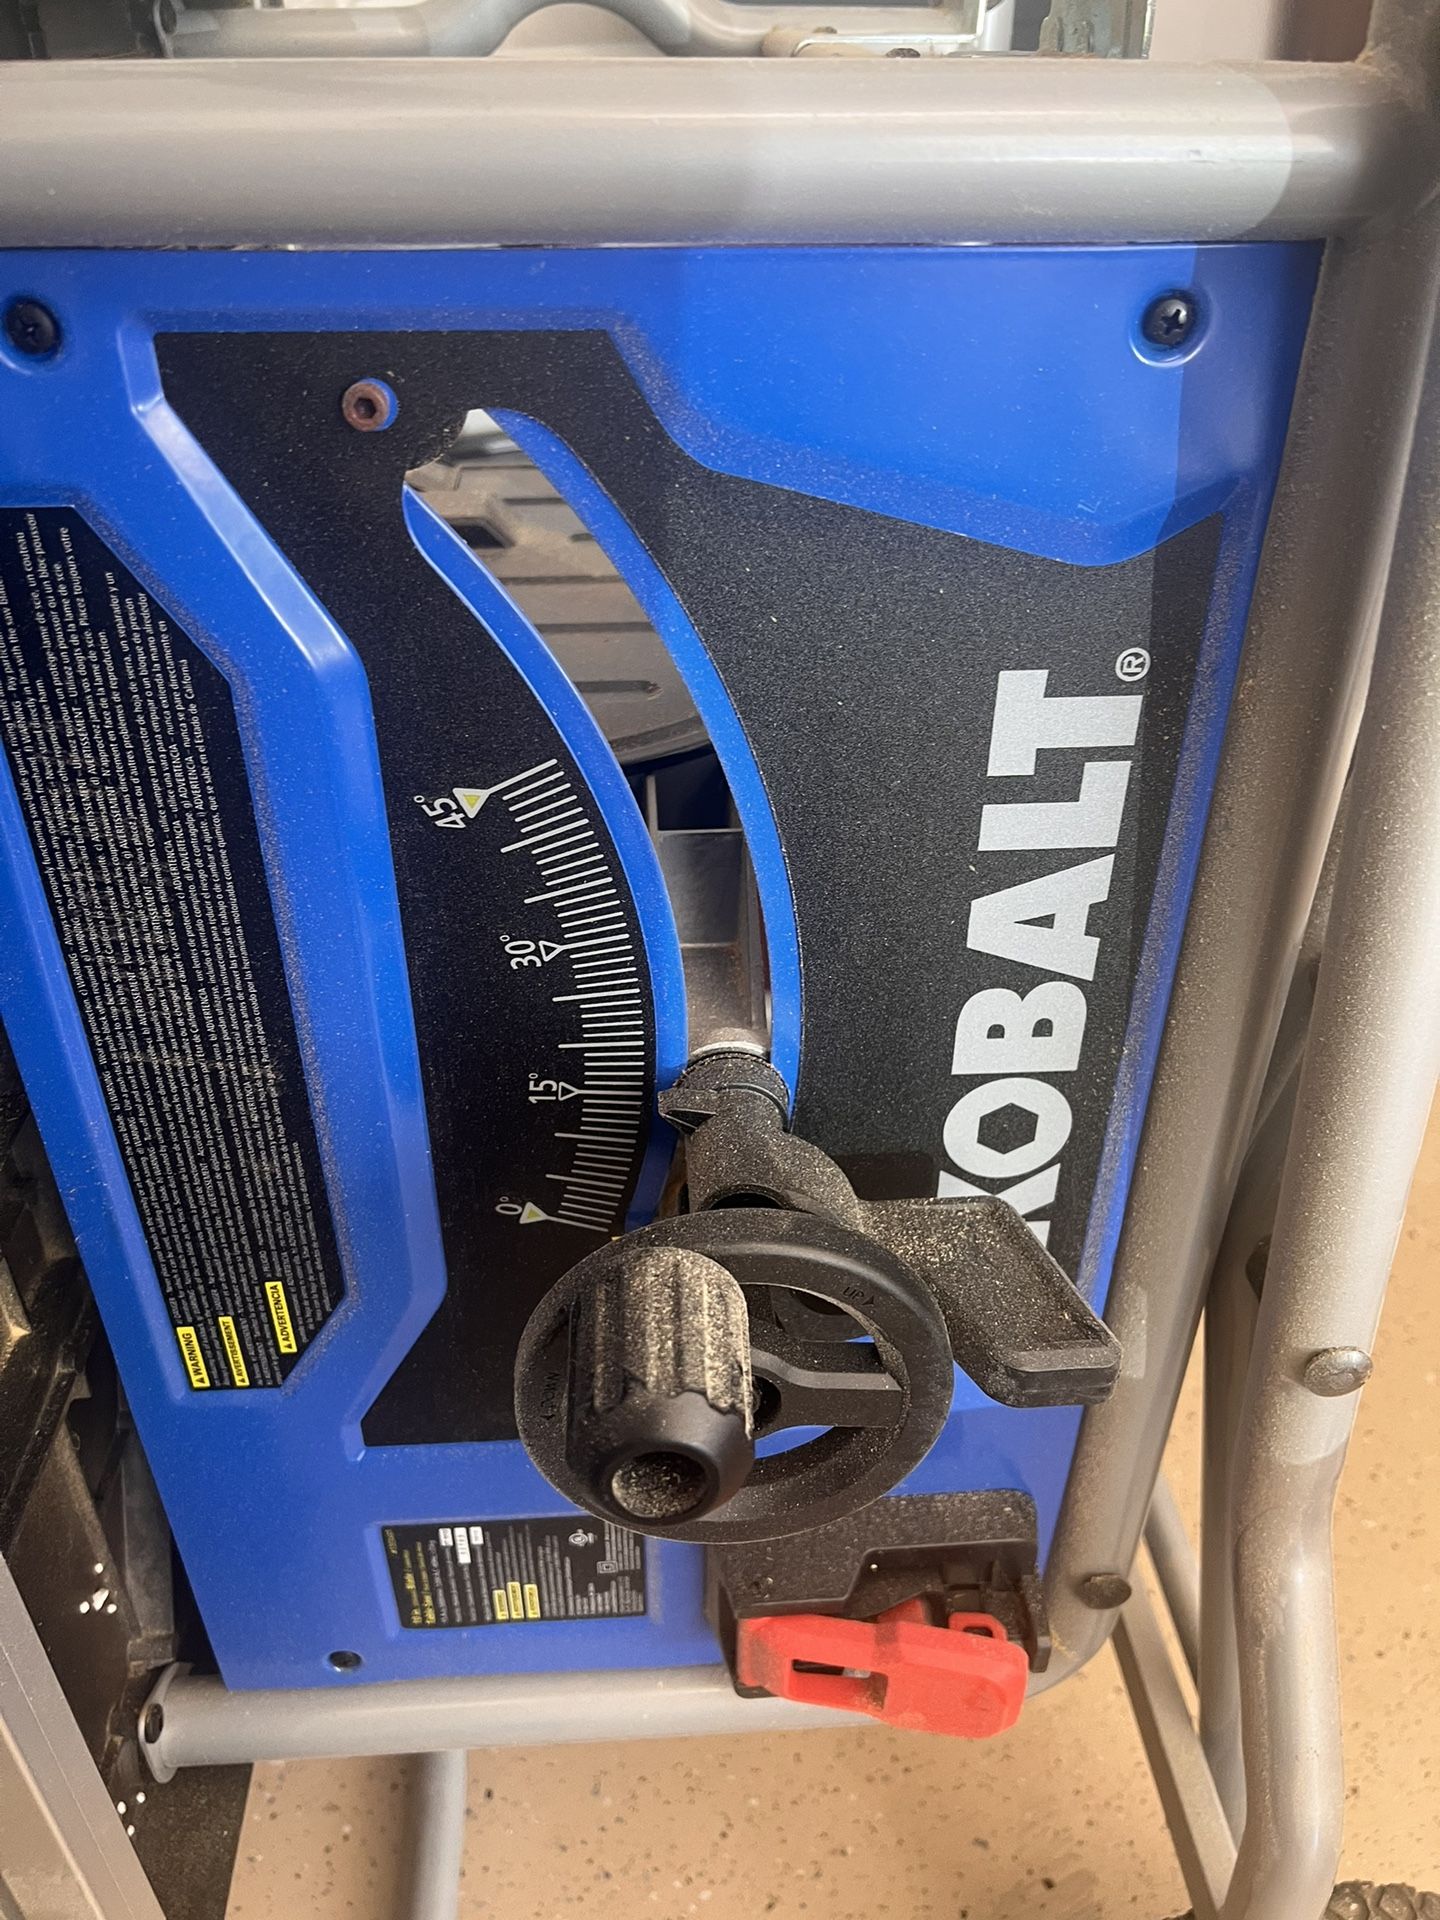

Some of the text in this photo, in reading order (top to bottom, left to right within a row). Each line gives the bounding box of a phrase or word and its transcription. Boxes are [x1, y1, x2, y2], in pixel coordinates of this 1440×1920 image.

[16, 532, 32, 571] couteau
[59, 527, 72, 552] votre
[53, 563, 64, 581] scie.
[66, 555, 82, 594] toujours
[30, 590, 41, 609] scie,
[61, 598, 73, 620] lame
[75, 597, 89, 625] Placez
[137, 592, 153, 634] alrededor
[2, 607, 12, 625] saw
[50, 610, 68, 648] poussoir
[109, 594, 126, 637] separador
[7, 627, 18, 643] the
[83, 630, 94, 647] scie.
[147, 636, 159, 661] mano
[11, 645, 24, 665] with
[73, 647, 87, 675] doigts
[98, 631, 118, 689] reproduction.
[135, 645, 148, 675] bloque
[160, 633, 178, 689] directamente
[7, 676, 16, 690] Pay
[18, 668, 29, 683] line
[63, 665, 78, 697] Utilisez
[81, 677, 90, 692] vos
[91, 663, 103, 685] lame
[131, 694, 142, 712] hoja
[153, 673, 168, 708] extienda
[172, 691, 185, 710] pare
[12, 700, 31, 743] WARNING
[25, 696, 41, 728] directly
[58, 701, 74, 737] toujours
[85, 694, 100, 722] jamais
[102, 710, 113, 728] face
[146, 698, 160, 732] empujar
[5, 722, 18, 746] riving
[42, 704, 62, 757] reproductive
[162, 710, 174, 735] nunca
[179, 722, 190, 747] nunca
[190, 715, 203, 743] Estado
[33, 730, 47, 753] stand
[68, 739, 82, 769] Utilisez
[72, 707, 96, 774] AVERTISSEMENT
[92, 724, 111, 776] N'approchez
[139, 726, 155, 763] protector
[154, 734, 166, 752] para
[41, 756, 54, 779] Never
[56, 758, 68, 781] other
[109, 743, 128, 792] directement
[126, 750, 139, 783] d'autres
[158, 753, 169, 771] vara
[169, 743, 188, 798] ADVERTENCIA
[201, 765, 211, 783] sabe
[150, 777, 163, 808] siempre
[163, 772, 172, 787] una
[185, 755, 204, 809] ADVERTENCIA
[39, 795, 56, 834] operation
[49, 788, 67, 828] WARNING
[65, 793, 79, 823] defects
[76, 778, 100, 841] AVERTISSEMENT
[122, 793, 137, 819] jamais
[167, 789, 178, 812] utilice
[208, 795, 218, 810] que
[413, 795, 466, 828] 45°
[105, 785, 128, 848] AVERTISSEMENT
[158, 809, 169, 832] utilice
[32, 820, 51, 864] functioning
[50, 835, 60, 849] any
[72, 824, 84, 843] birth
[128, 821, 143, 845] placez
[172, 820, 191, 871] ADVERTENCIA
[184, 812, 201, 856] contragolpe.
[200, 820, 213, 843] ajuste.
[54, 851, 70, 882] perform
[135, 846, 146, 865] vous
[164, 839, 182, 890] ADVERTENCIA
[206, 853, 219, 882] cambiar
[218, 848, 232, 880] contiene
[44, 866, 62, 897] properly
[148, 848, 167, 902] malformations
[62, 884, 72, 896] not
[188, 884, 202, 917] completo.
[162, 904, 171, 917] des
[167, 928, 179, 951] cancer
[499, 934, 543, 970] 30°
[175, 960, 186, 982] causer
[528, 1072, 557, 1104] 15°
[495, 1196, 523, 1215] 0°
[842, 1286, 864, 1300] UP
[269, 1284, 293, 1343] ADVERTENCIA
[181, 1332, 203, 1375] WARNING
[221, 1320, 243, 1377] AVERTISSEMENT
